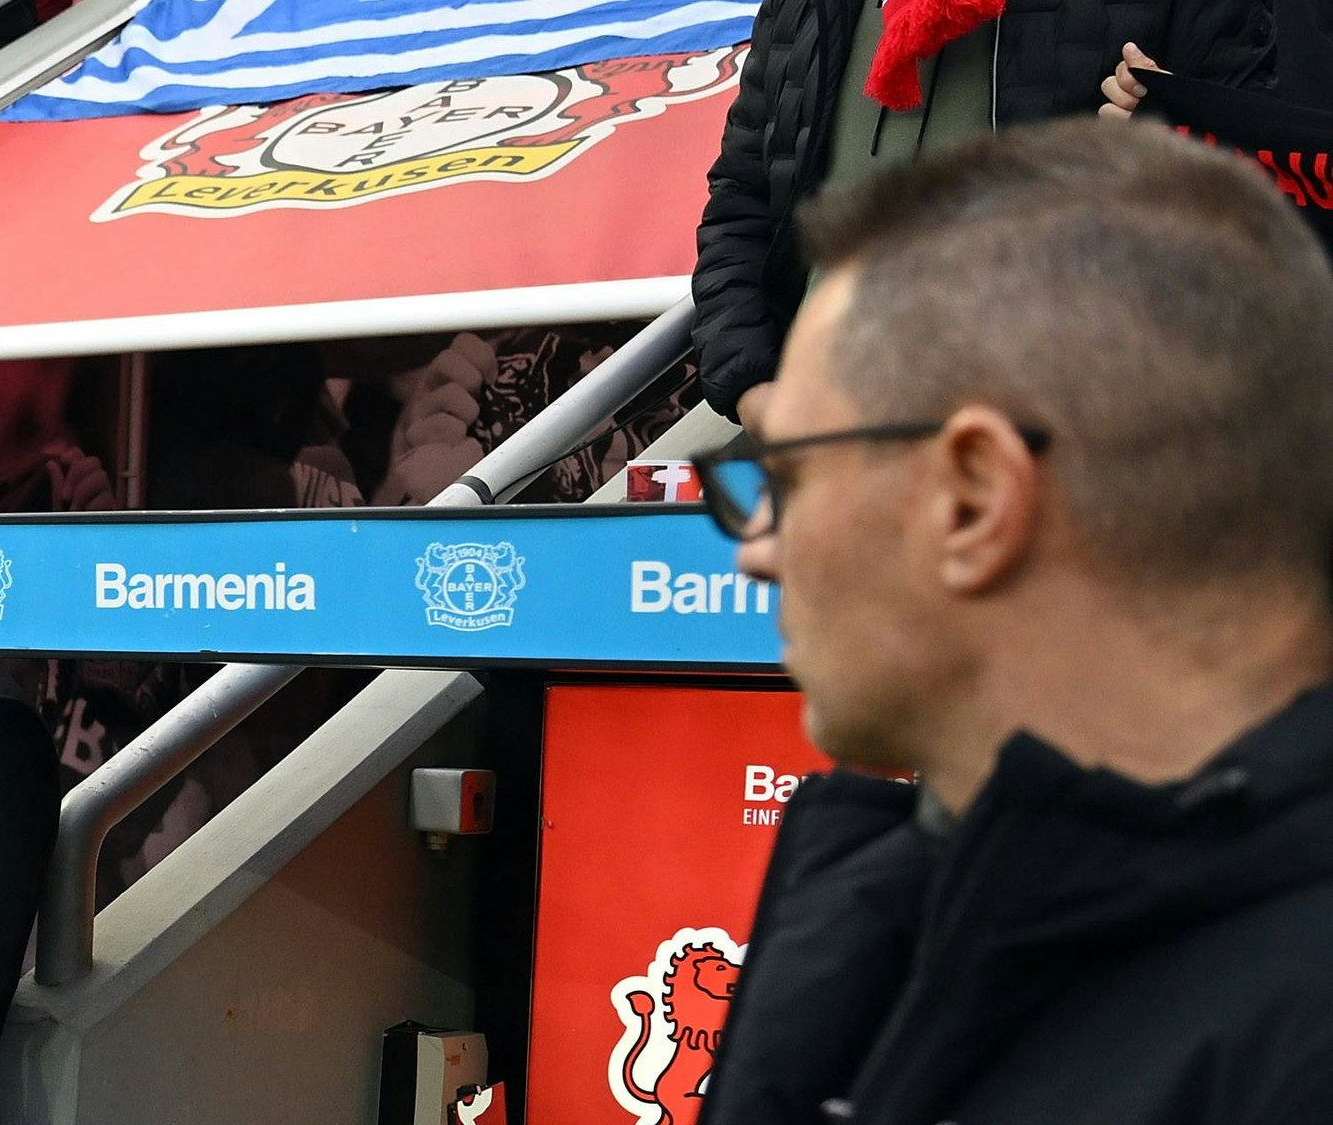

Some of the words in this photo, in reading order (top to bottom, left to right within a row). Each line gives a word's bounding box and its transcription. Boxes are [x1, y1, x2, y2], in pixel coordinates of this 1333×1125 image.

[297, 106, 533, 136] BAYER
[149, 153, 526, 200] Leverkusen
[95, 562, 316, 611] Barmenia
[448, 582, 492, 592] BAYER
[631, 561, 772, 614] Barm
[434, 611, 506, 628] Leverkusen
[743, 809, 781, 826] EINF
